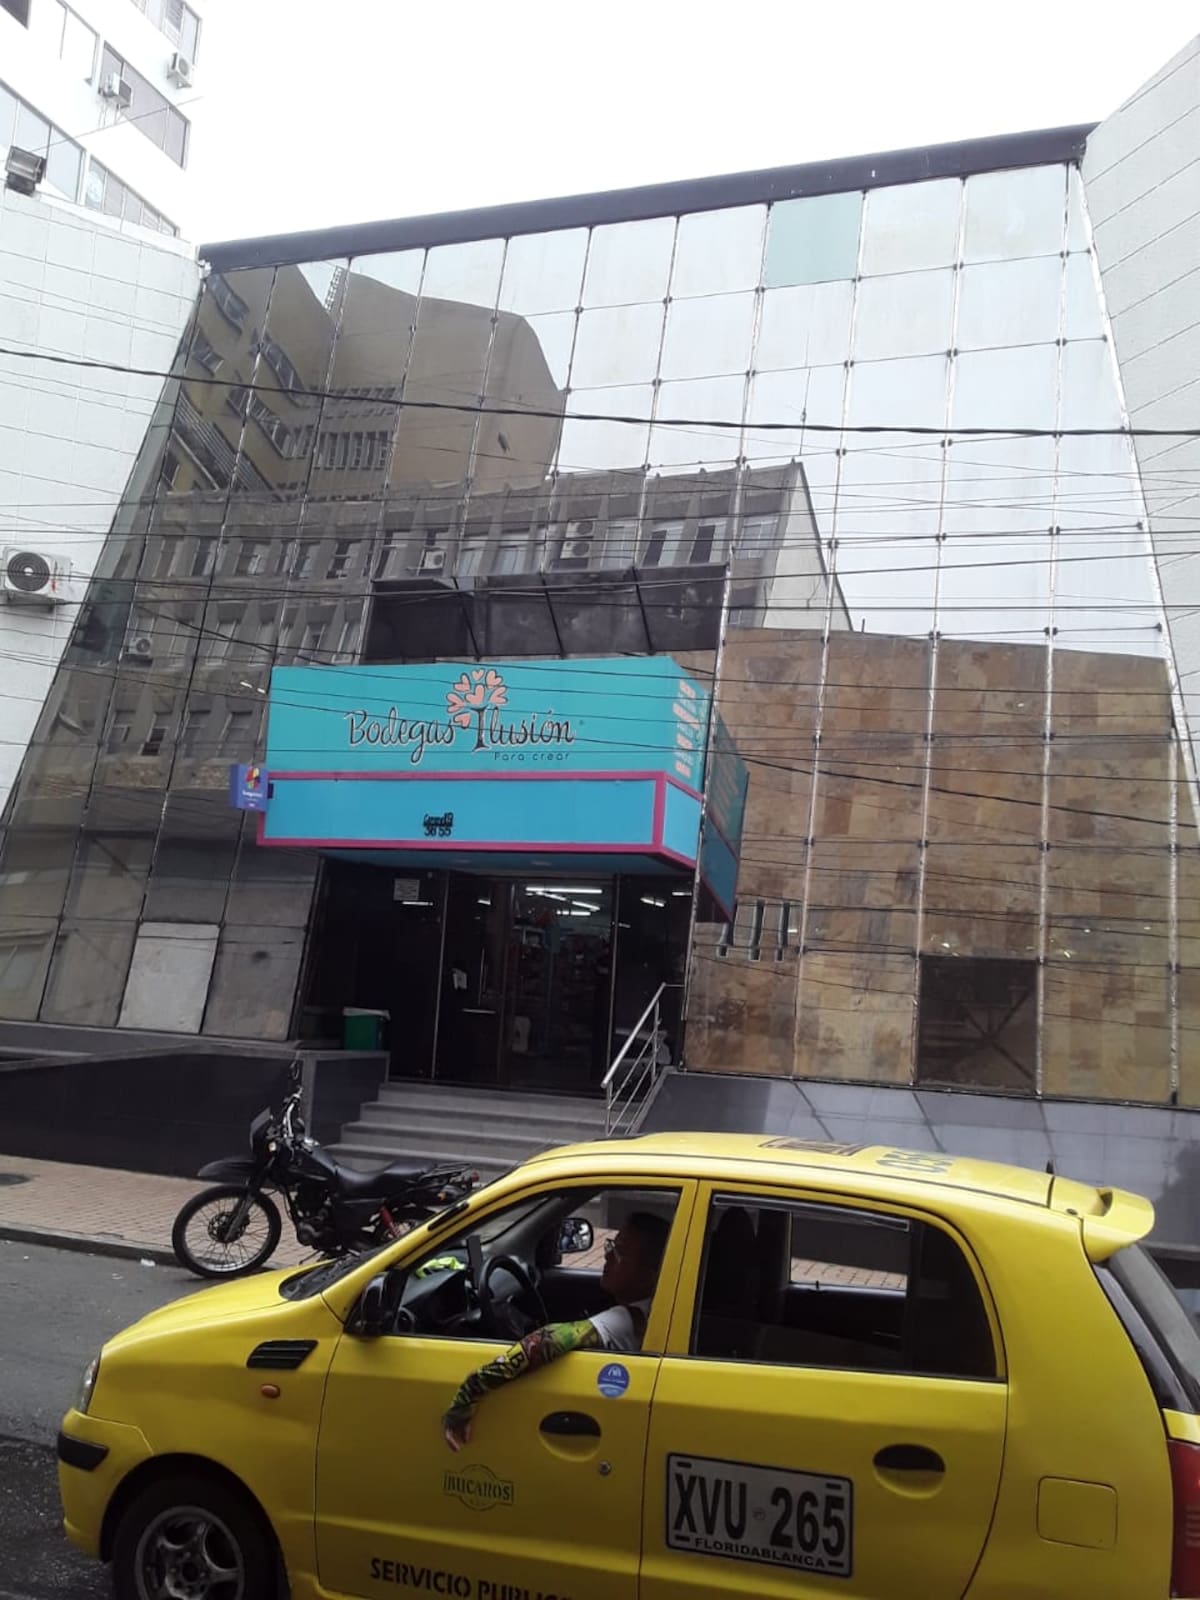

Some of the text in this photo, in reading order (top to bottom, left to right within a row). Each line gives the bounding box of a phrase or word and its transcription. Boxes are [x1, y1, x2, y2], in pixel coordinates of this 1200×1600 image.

[344, 706, 576, 766] Bodegas Ilusión
[494, 751, 571, 761] Para crear
[449, 1475, 512, 1502] BUCAROS
[673, 1472, 847, 1557] XVU 265
[695, 1537, 826, 1569] FLORIDABLANCA
[370, 1557, 575, 1600] SERVICIO PUBL
